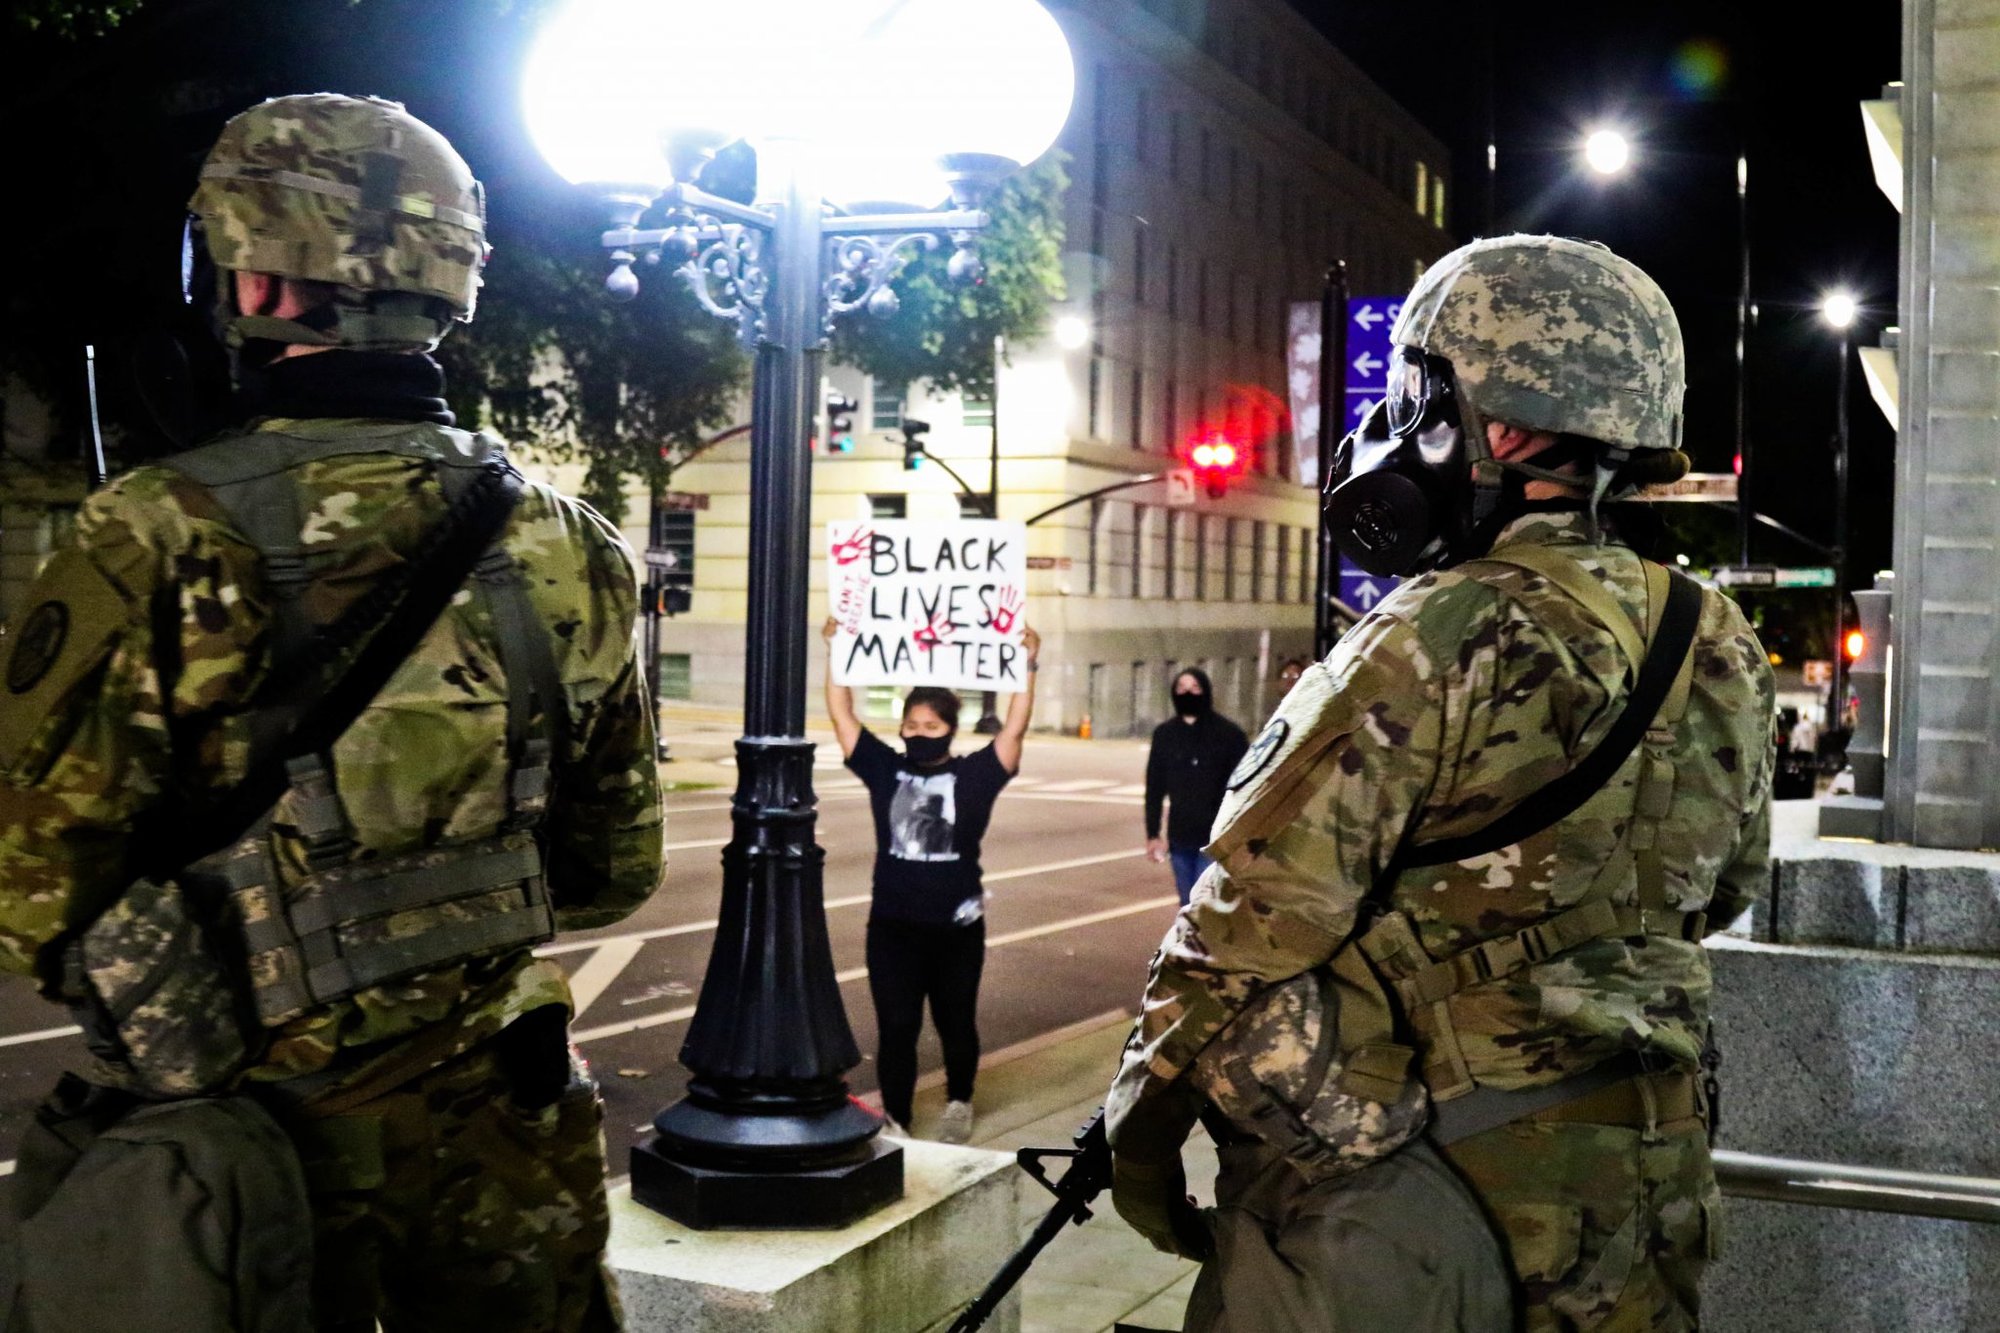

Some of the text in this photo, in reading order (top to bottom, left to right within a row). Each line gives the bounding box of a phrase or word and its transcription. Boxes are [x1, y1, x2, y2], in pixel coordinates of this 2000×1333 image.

[869, 533, 1008, 577] BLACK
[871, 584, 997, 629] LIVES
[845, 633, 1017, 682] MATTER
